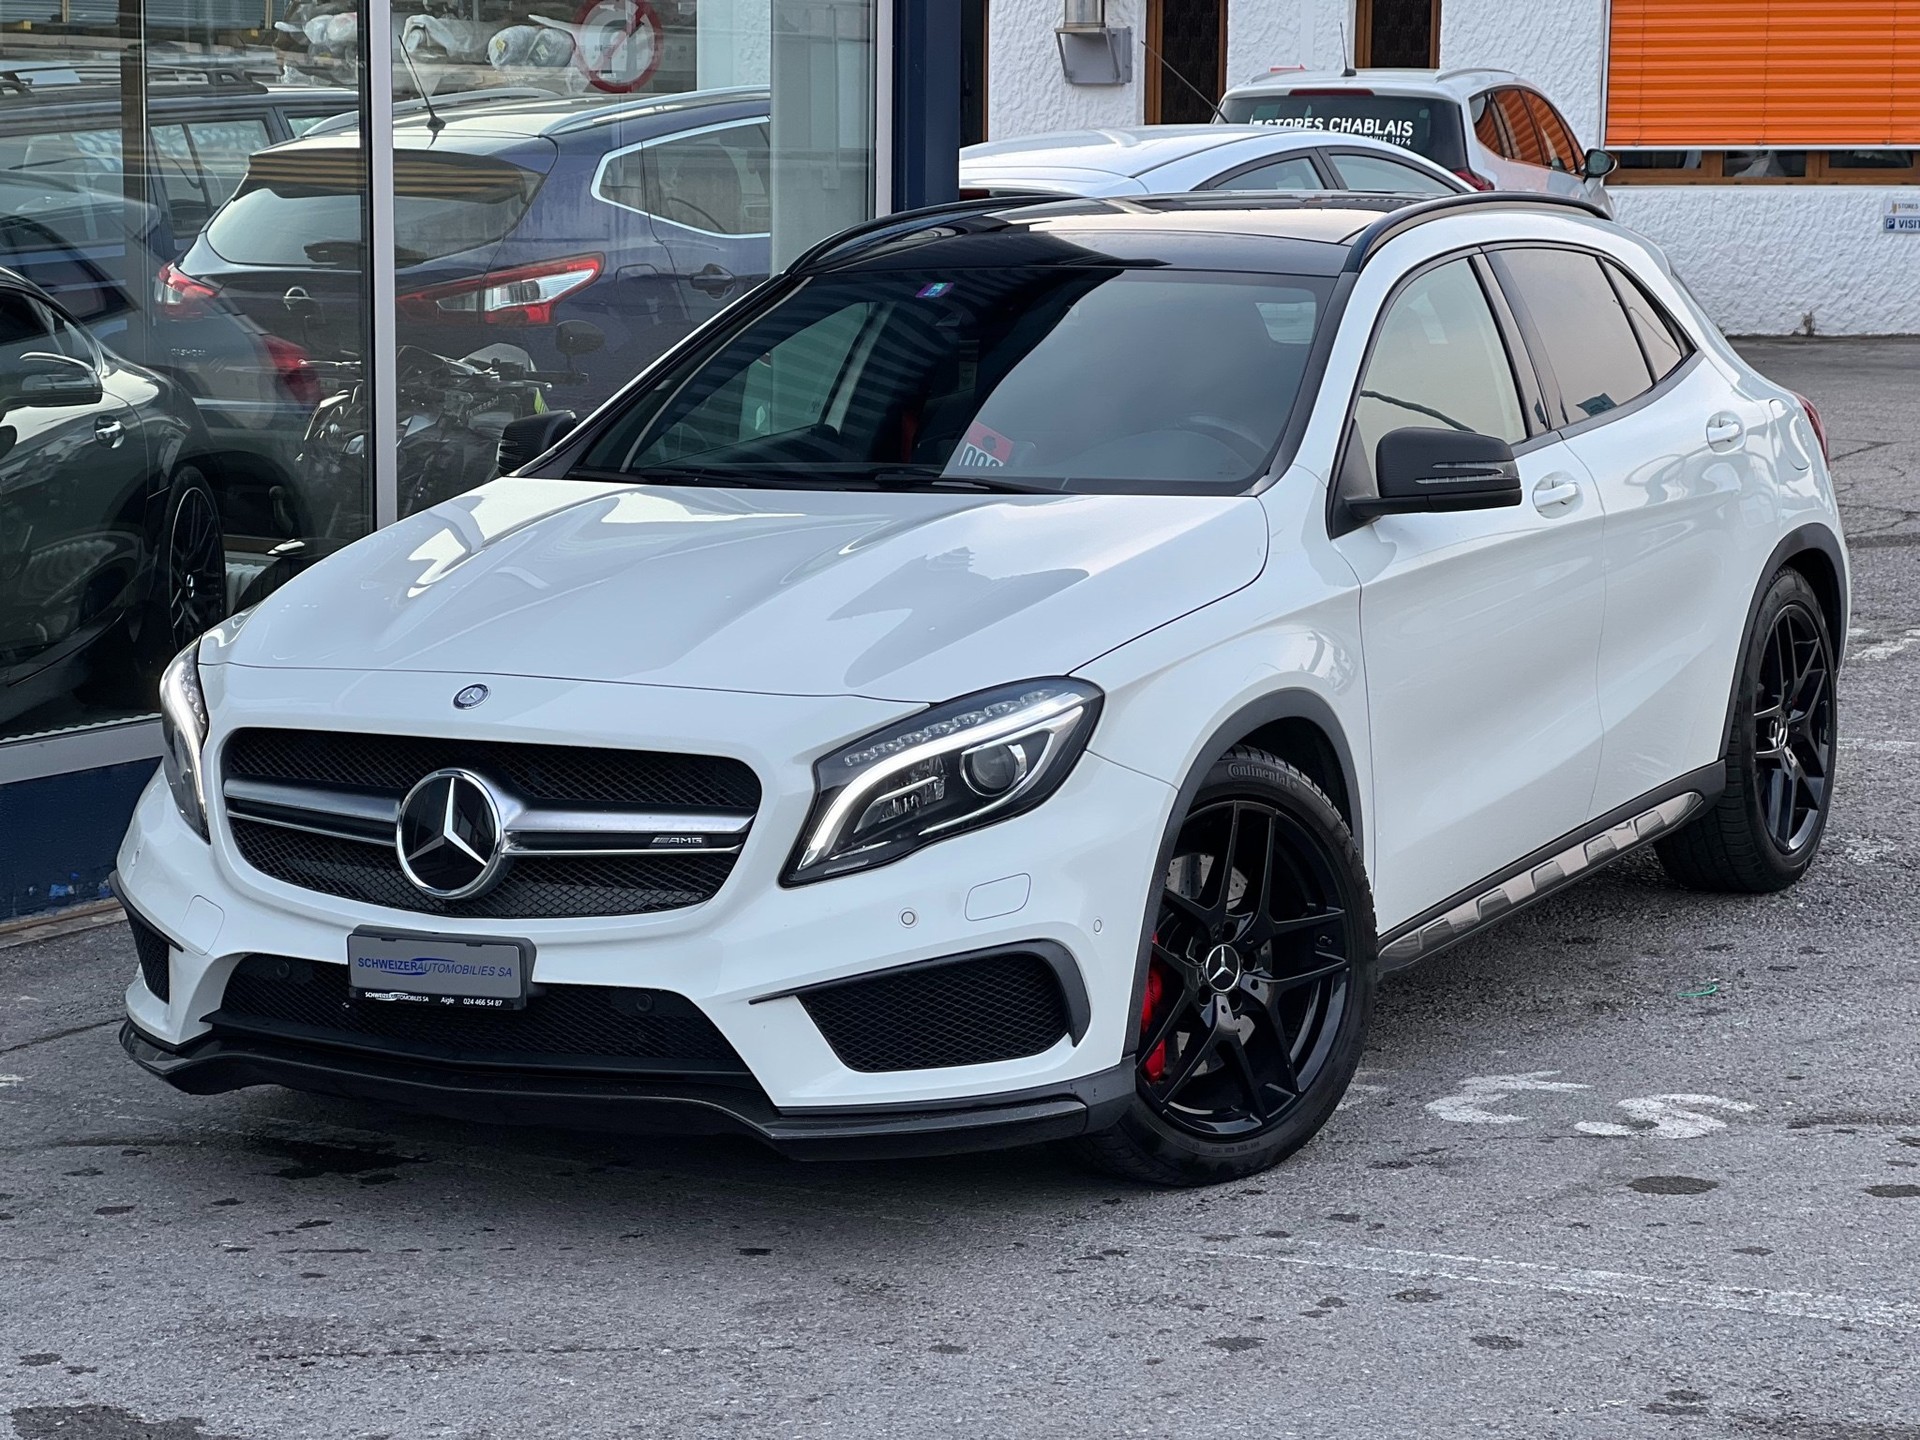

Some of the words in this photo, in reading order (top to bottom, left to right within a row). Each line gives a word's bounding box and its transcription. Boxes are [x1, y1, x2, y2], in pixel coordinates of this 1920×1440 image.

[1328, 117, 1413, 137] CHABLAIS
[1227, 763, 1291, 788] Continental
[497, 966, 513, 978] SA
[440, 996, 455, 1005] Aigle
[463, 998, 474, 1006] 024
[474, 998, 486, 1006] 466
[486, 999, 494, 1007] 54
[494, 999, 503, 1007] 87
